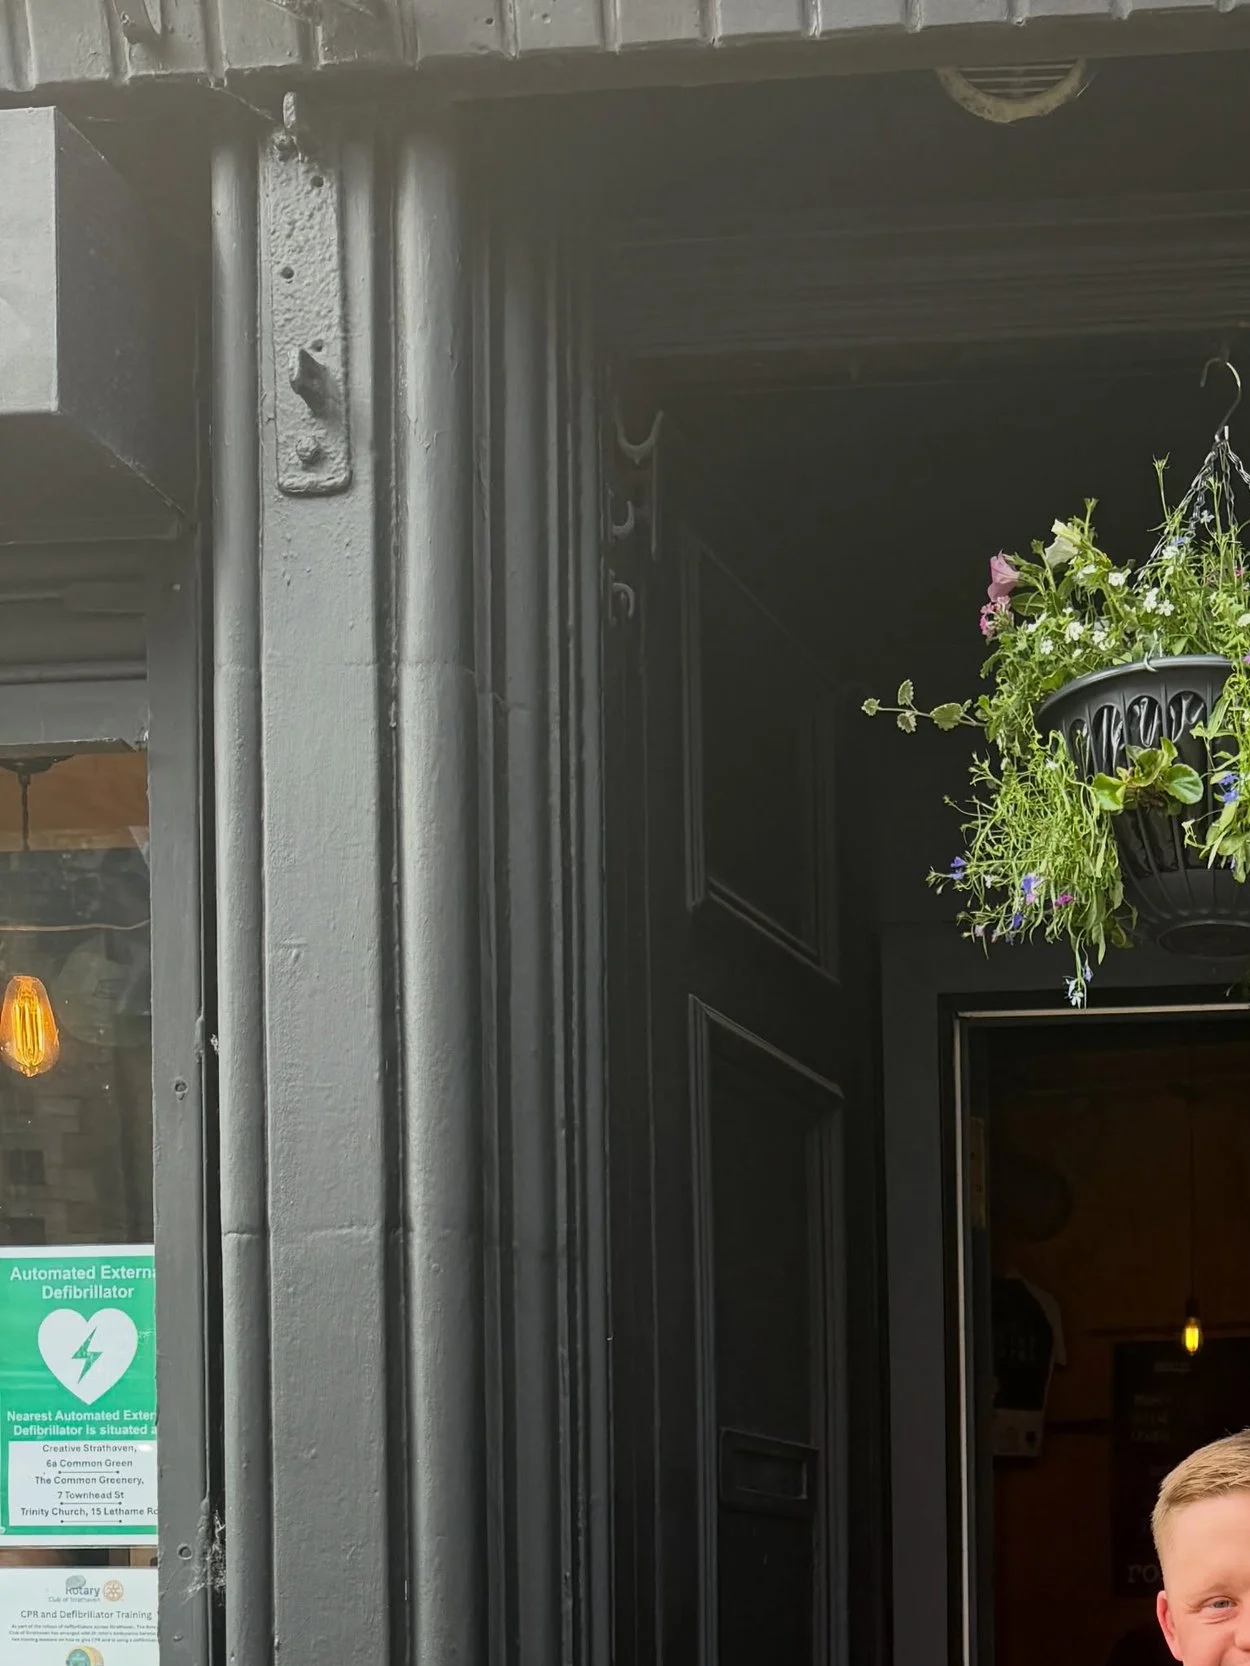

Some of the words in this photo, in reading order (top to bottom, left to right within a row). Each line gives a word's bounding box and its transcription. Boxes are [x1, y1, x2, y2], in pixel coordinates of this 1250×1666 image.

[10, 1265, 95, 1280] Automated
[42, 1285, 135, 1300] Defibrillator
[7, 1411, 52, 1422] Nearest
[55, 1410, 120, 1421] Automated
[13, 1425, 83, 1436] Defibrillator
[86, 1425, 96, 1435] is
[99, 1424, 147, 1435] situated
[42, 1444, 81, 1453] Creative
[83, 1444, 137, 1453] Strathaven,
[46, 1459, 57, 1468] 6a
[59, 1459, 102, 1467] Common
[104, 1459, 133, 1467] Green
[35, 1476, 51, 1485] The
[54, 1476, 97, 1484] Common
[57, 1491, 63, 1499] 7
[65, 1491, 112, 1499] Townhead
[114, 1491, 124, 1499] St
[21, 1508, 49, 1517] Trinity
[51, 1508, 88, 1517] Church,
[91, 1508, 101, 1516] 15
[65, 1586, 100, 1597] Rotary
[21, 1610, 39, 1619] CPR
[41, 1610, 57, 1619] and
[60, 1610, 114, 1619] Defibrillator
[116, 1610, 152, 1621] Training
